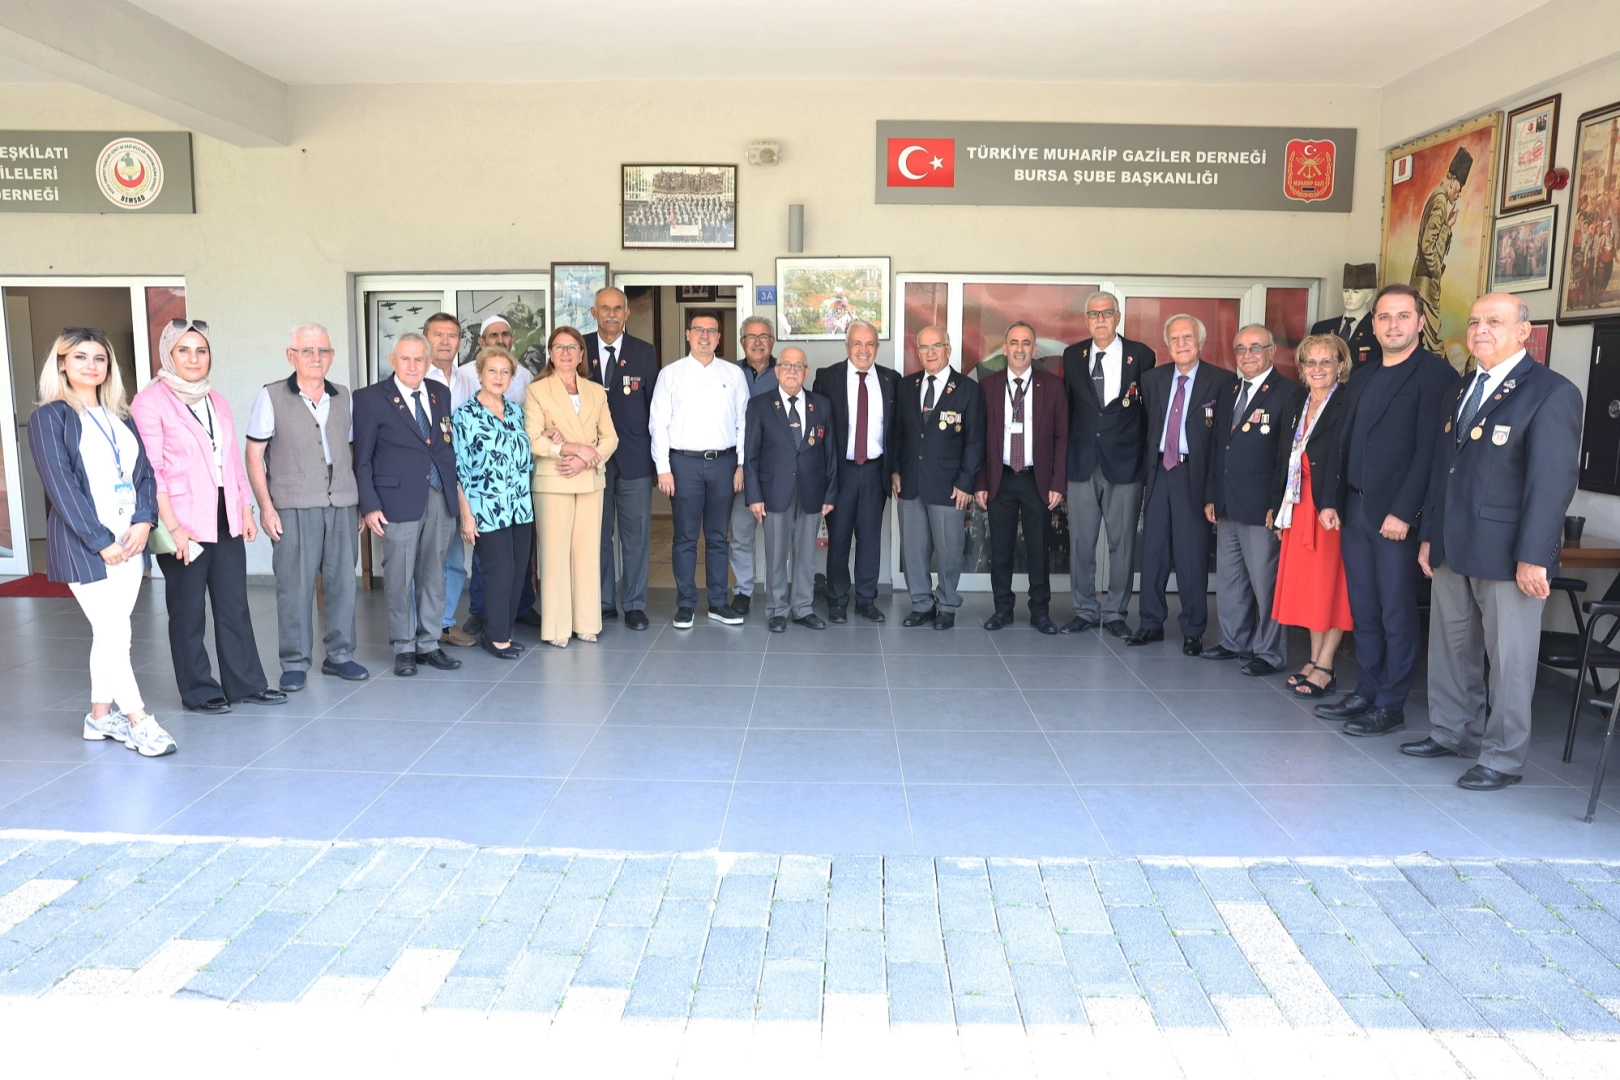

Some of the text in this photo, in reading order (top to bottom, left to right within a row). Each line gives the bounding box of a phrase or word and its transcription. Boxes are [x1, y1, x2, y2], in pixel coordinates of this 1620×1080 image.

[0, 144, 69, 161] EŞKİLATI
[966, 144, 1266, 164] TÜRKİYE MUHARİP GAZİLER DERNEĞİ
[1014, 169, 1218, 187] BURSA ŞUBE BAŞKANLIĞI
[0, 186, 59, 201] ERNEĞİ
[761, 291, 773, 301] 3A
